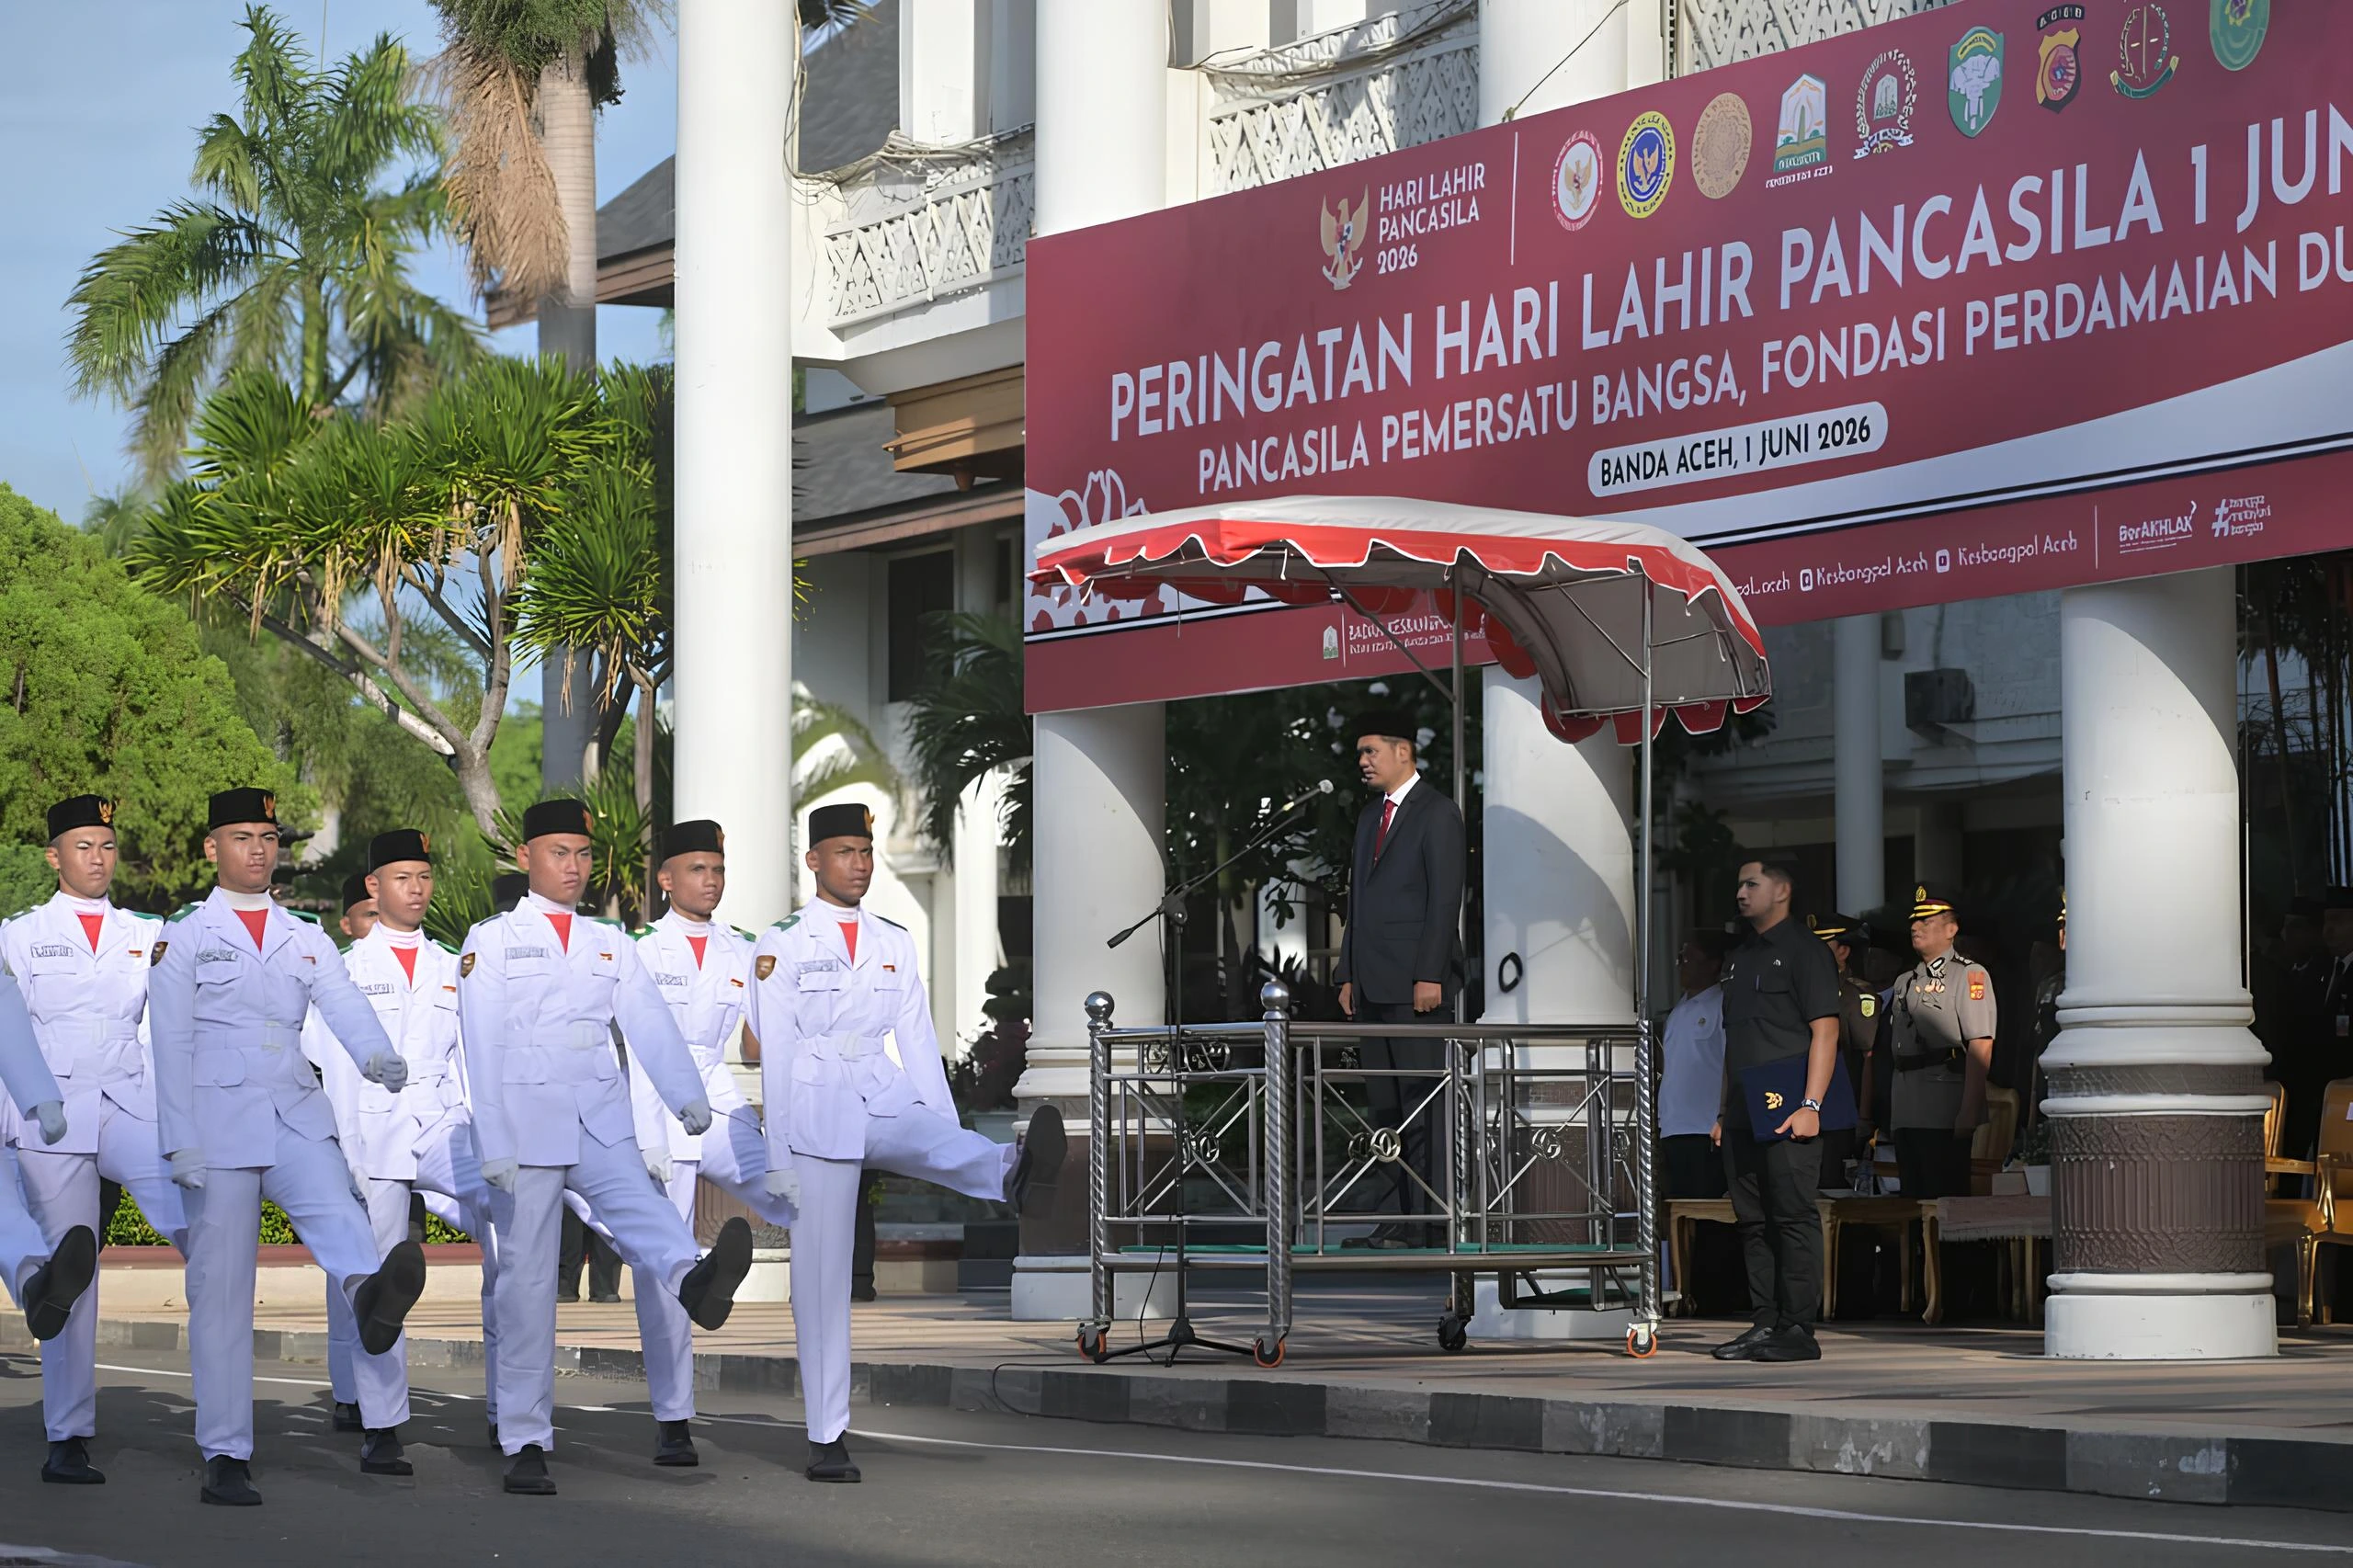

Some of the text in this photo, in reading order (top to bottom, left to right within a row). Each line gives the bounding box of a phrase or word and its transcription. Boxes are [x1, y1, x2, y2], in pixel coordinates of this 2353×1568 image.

[1380, 163, 1485, 213] HARI LAHIR
[1379, 195, 1480, 244] PANCASILA
[1377, 243, 1418, 275] 2026
[1111, 313, 1413, 442] PERINGATAN
[1436, 280, 1559, 380] HARI
[1582, 241, 1754, 350] LAHIR
[1780, 148, 2164, 310] PANCASILA
[2191, 143, 2207, 225] 1
[1199, 420, 1370, 494] PANCASILA
[1381, 380, 1577, 463] PEMERSATU
[1593, 348, 1746, 425] BANGSA,
[1762, 306, 1945, 394] FONDASI
[1966, 240, 2277, 356] PERDAMAIAN
[1601, 415, 1871, 487] BANDA ACEH, 1 JUNI 2026
